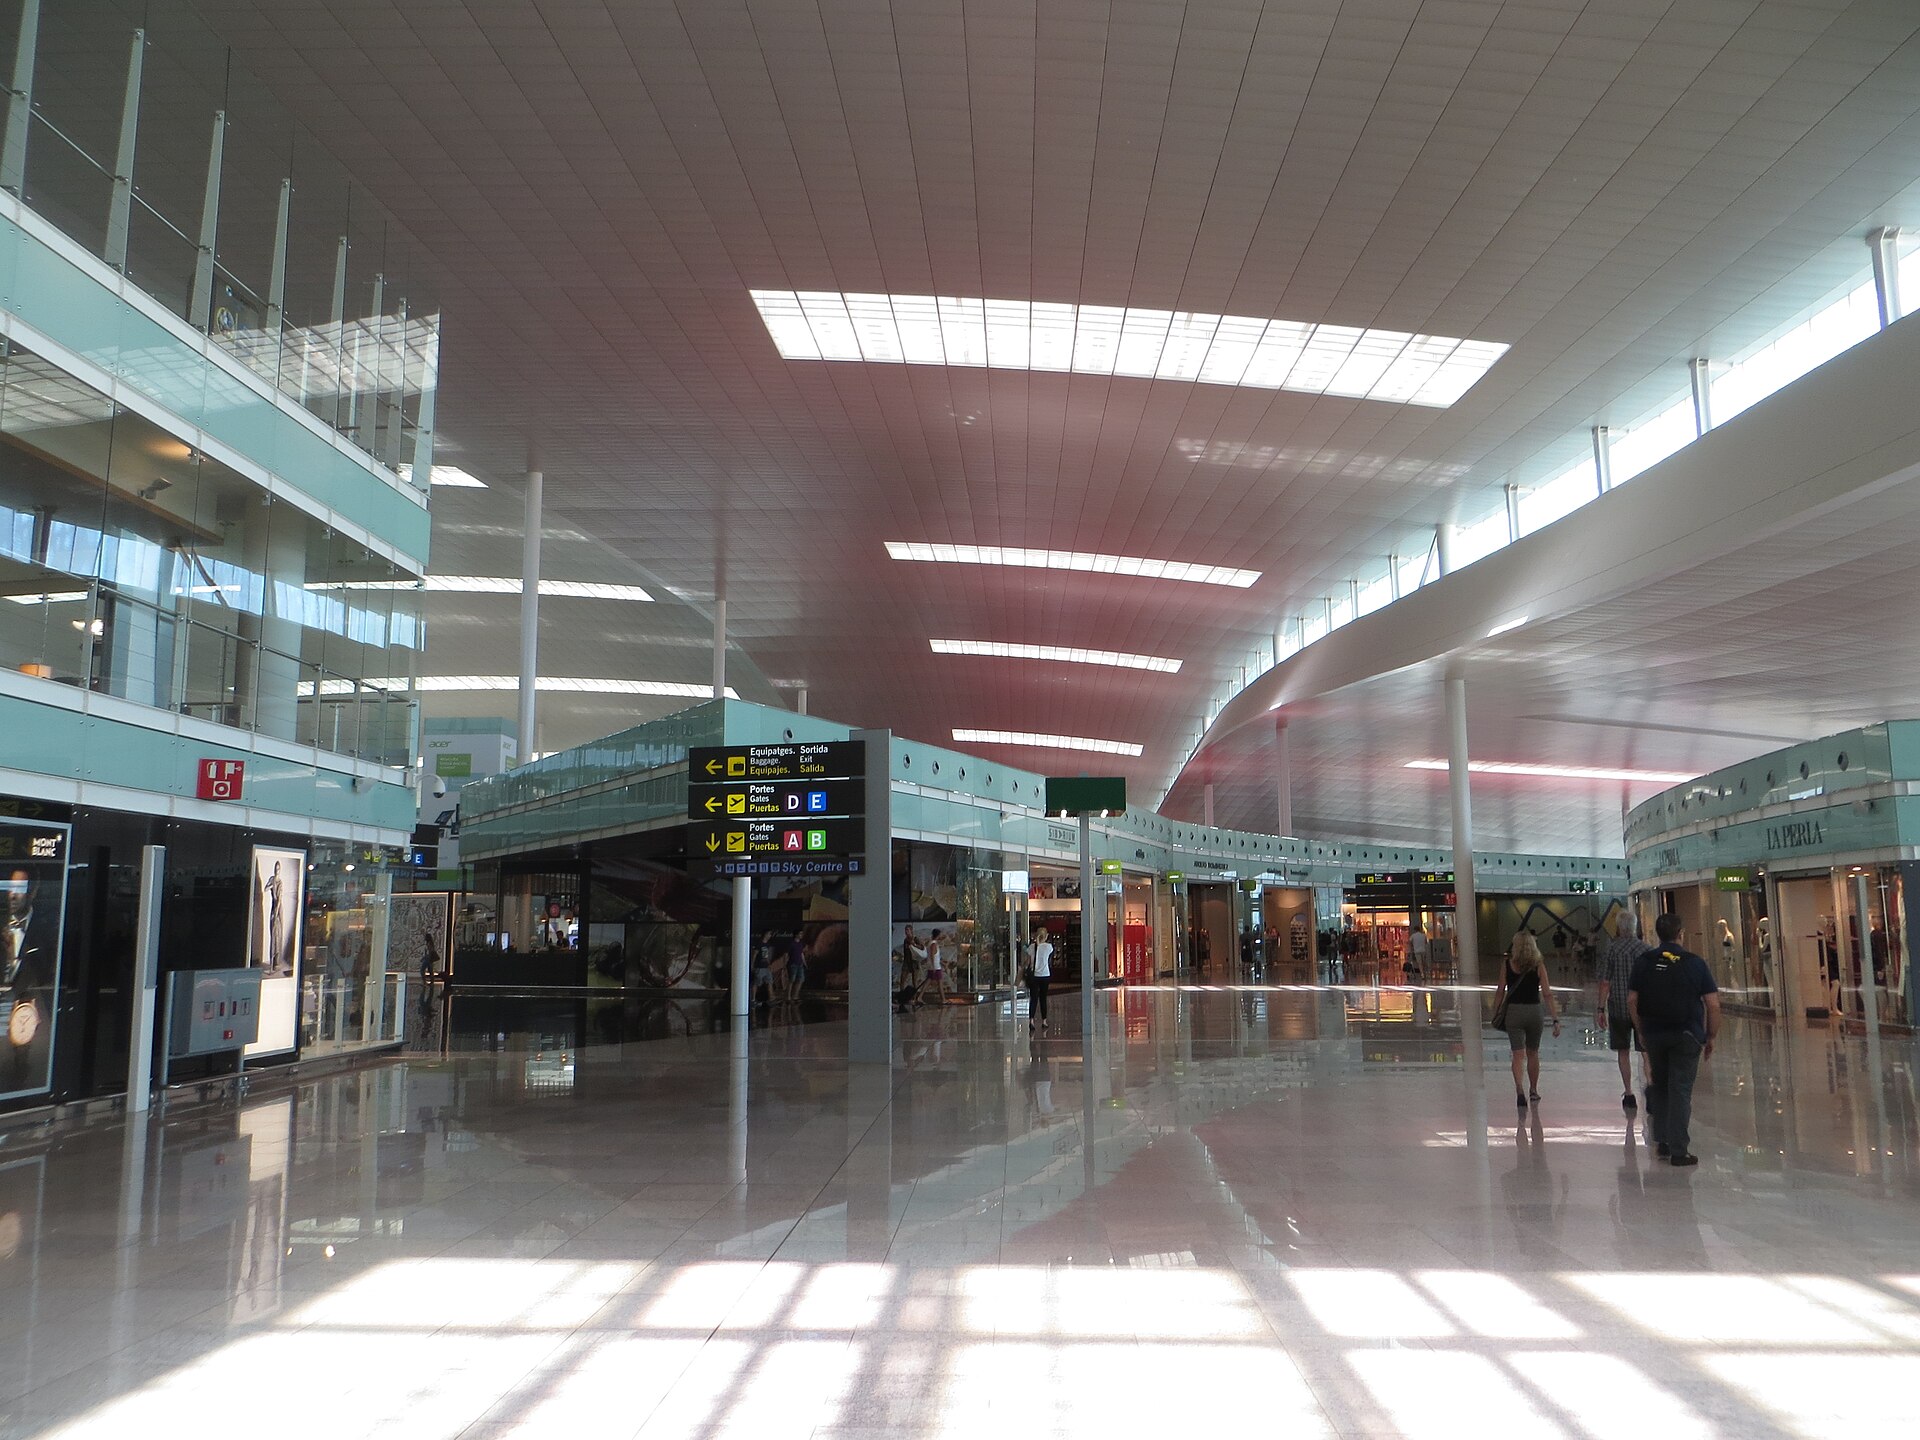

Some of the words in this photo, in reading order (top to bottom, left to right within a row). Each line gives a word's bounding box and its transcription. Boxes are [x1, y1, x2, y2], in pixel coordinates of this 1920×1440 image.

[750, 747, 796, 757] Equipatges.
[800, 745, 829, 754] Sortida
[750, 757, 781, 766] Baggage.
[800, 755, 813, 763] Exit
[750, 766, 791, 776] Equipajes.
[800, 764, 825, 773] Salida
[749, 785, 775, 794] Portes
[749, 794, 770, 803] Gates
[787, 794, 799, 810] D
[812, 793, 822, 809] E
[749, 804, 780, 812] Puertas
[749, 823, 775, 832] Portes
[749, 833, 769, 841] Gates
[788, 833, 799, 848] A
[812, 832, 822, 848] B
[1766, 827, 1781, 851] LA
[1782, 819, 1824, 849] PERLA
[32, 837, 57, 848] MONT
[749, 842, 780, 851] Puertas
[31, 847, 57, 857] BLANC
[415, 854, 421, 864] E
[782, 862, 802, 874] Sky
[806, 861, 843, 872] Centre
